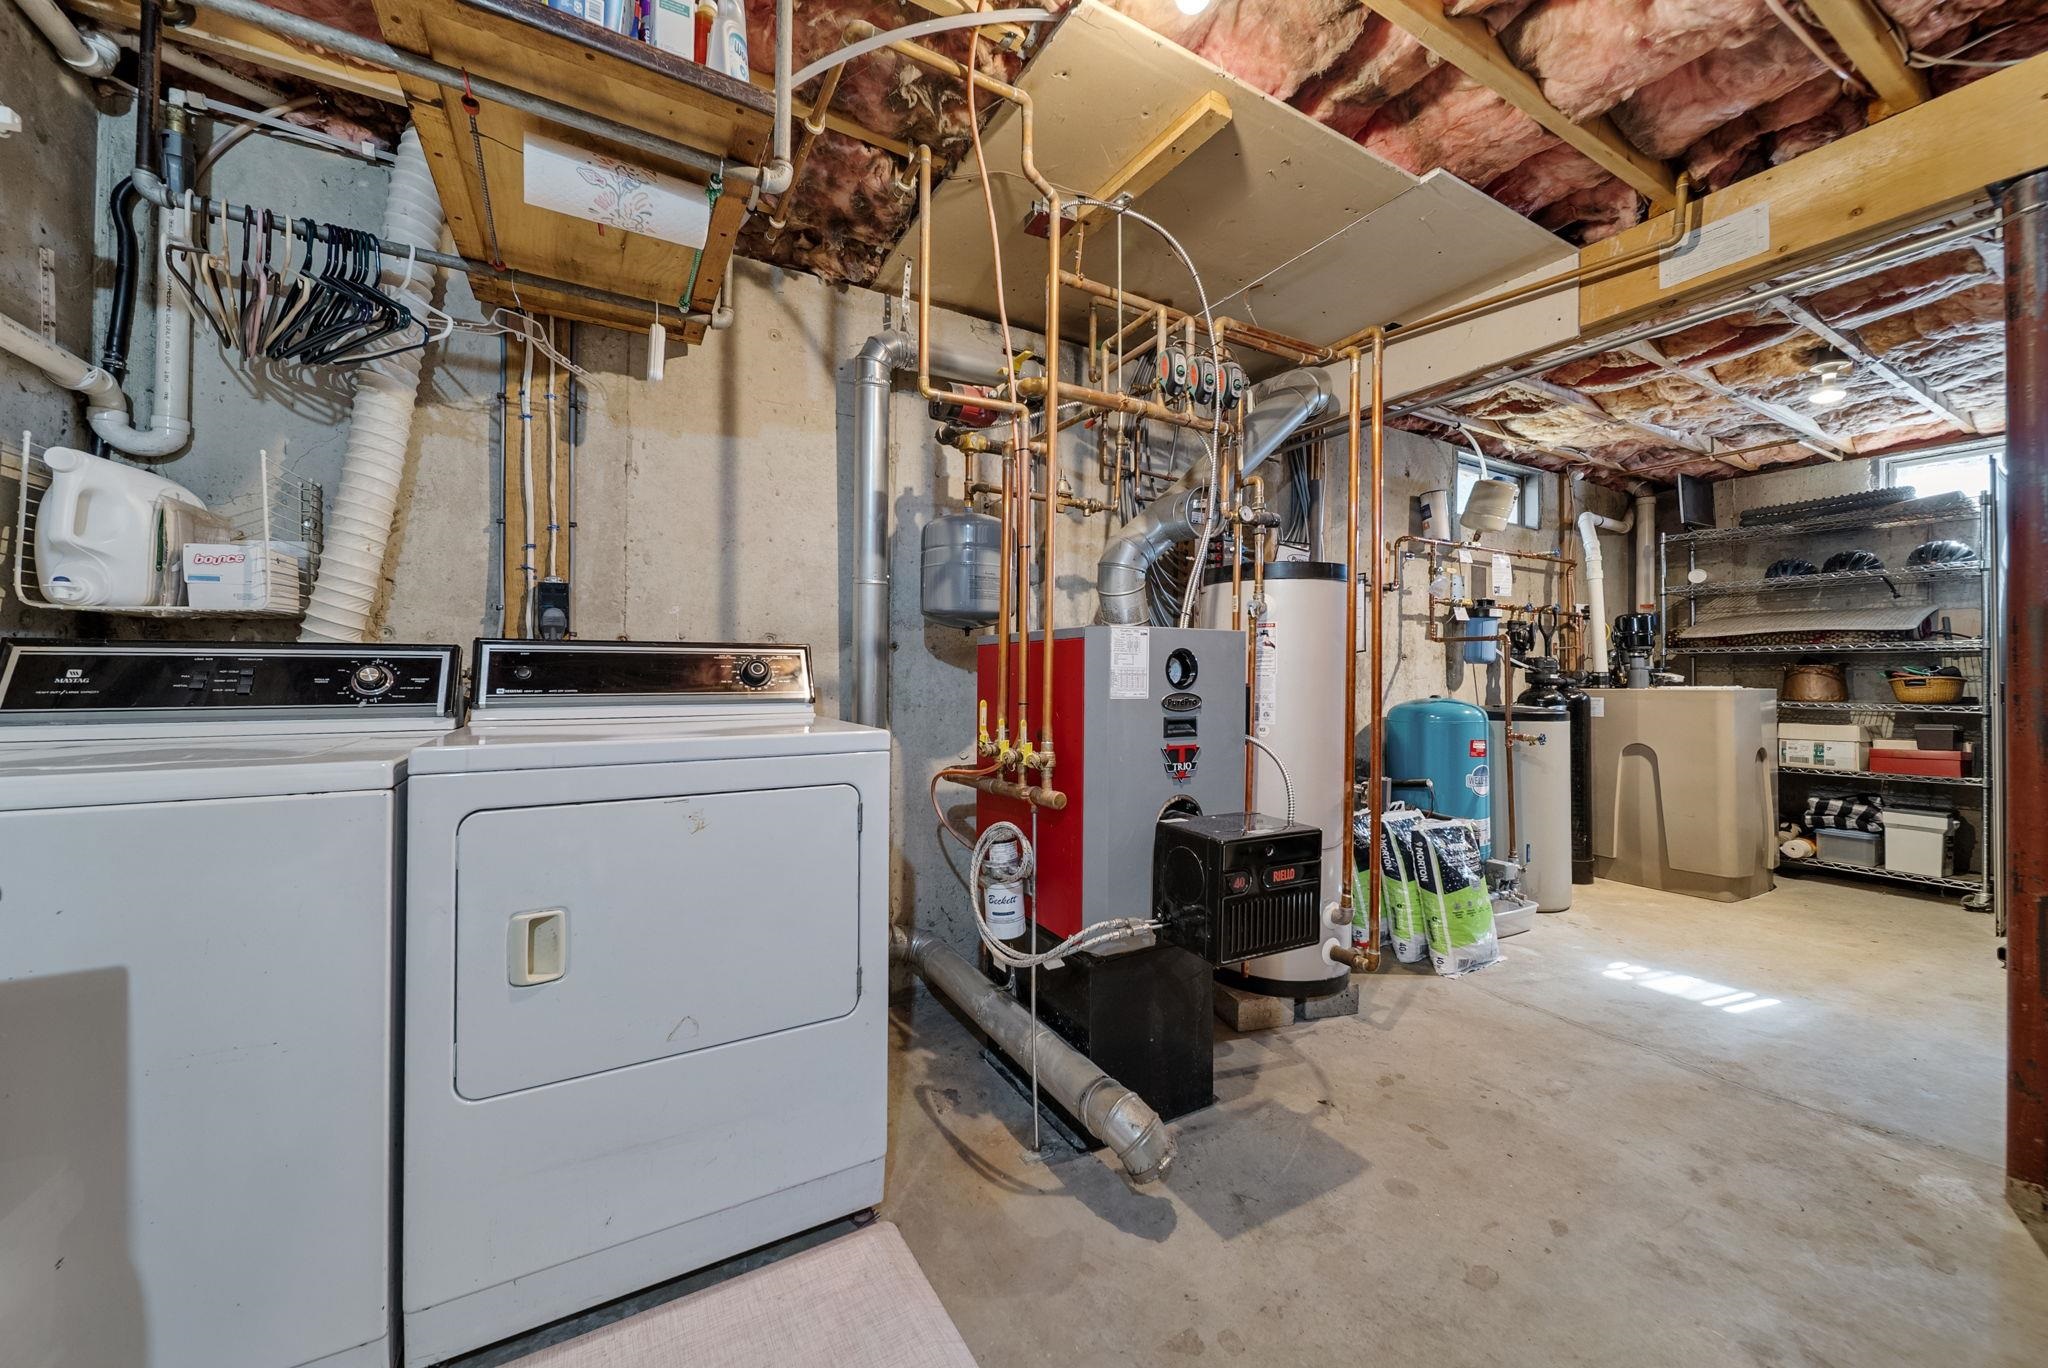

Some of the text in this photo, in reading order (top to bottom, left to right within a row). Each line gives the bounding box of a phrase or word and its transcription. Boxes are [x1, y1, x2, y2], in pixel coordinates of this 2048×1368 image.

[194, 554, 245, 565] bounce
[1166, 698, 1198, 708] PurePro
[1172, 762, 1192, 771] TRIO
[1381, 838, 1394, 871] MORTON
[1416, 847, 1429, 882] MORTON
[1272, 868, 1295, 882] RIELLO
[1233, 876, 1246, 889] 40
[988, 894, 1017, 905] Beckett
